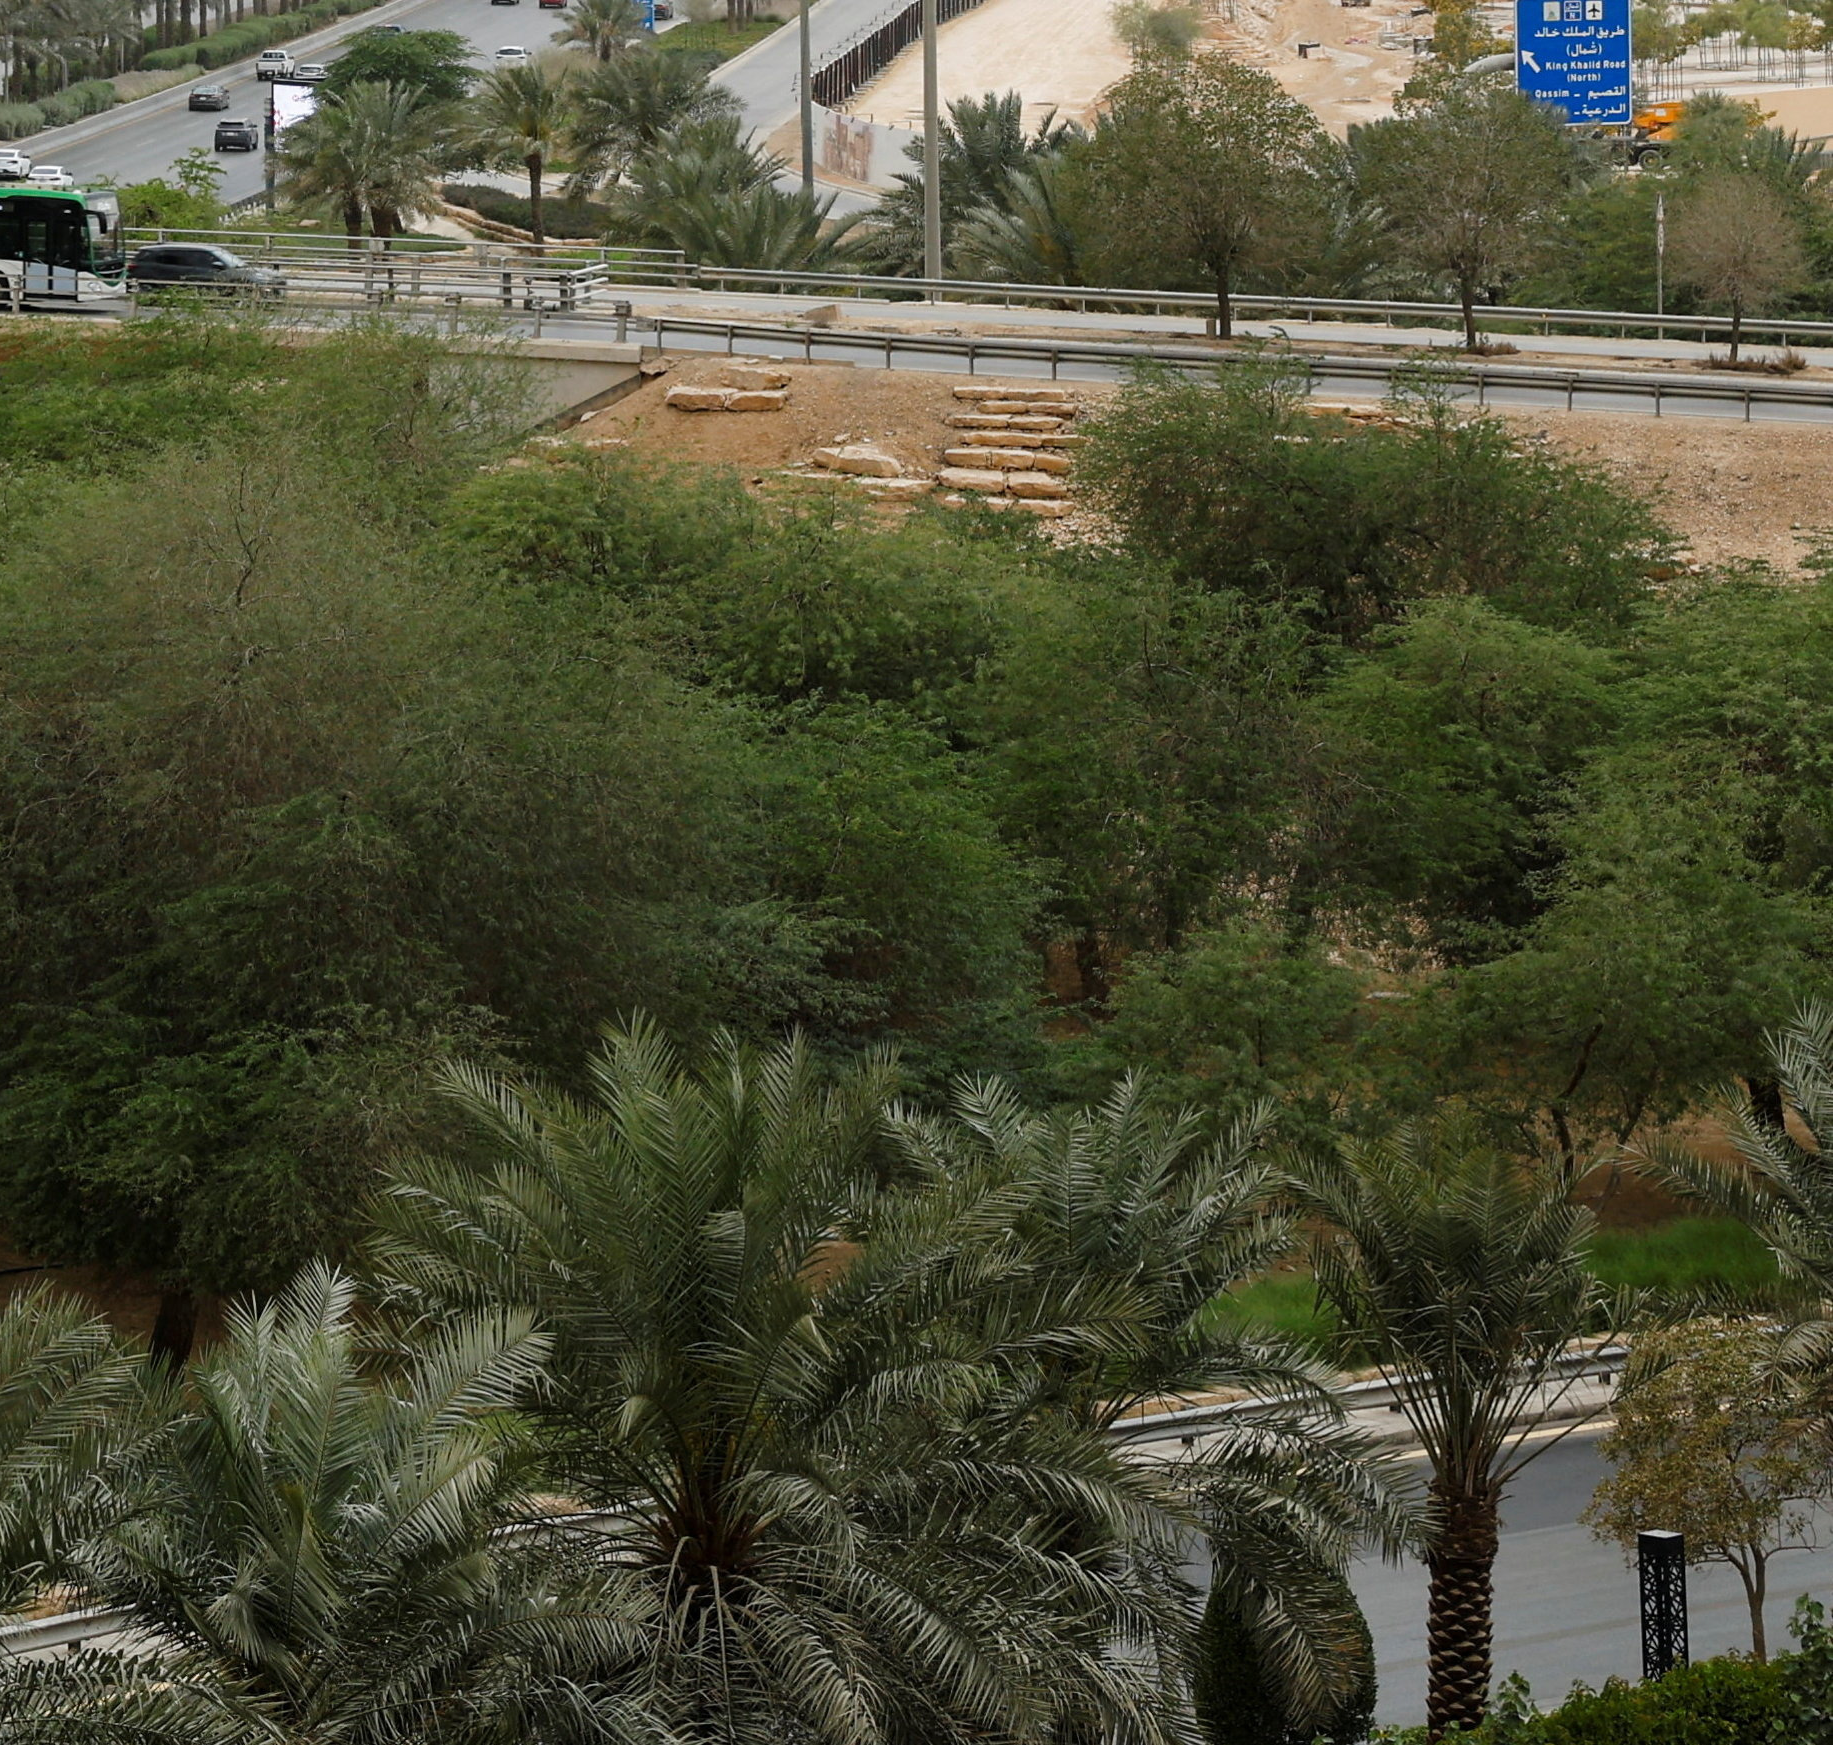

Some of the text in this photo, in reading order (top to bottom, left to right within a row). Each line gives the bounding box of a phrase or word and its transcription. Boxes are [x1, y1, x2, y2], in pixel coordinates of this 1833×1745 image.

[1534, 24, 1625, 38] طريق الملك خالد
[1566, 42, 1602, 57] (شمال)
[1546, 60, 1626, 71] King Khalid Road
[1567, 73, 1601, 82] (North)
[1535, 90, 1570, 98] Qassim
[1588, 86, 1626, 100] القصيم
[1582, 104, 1626, 116] الدرعية
